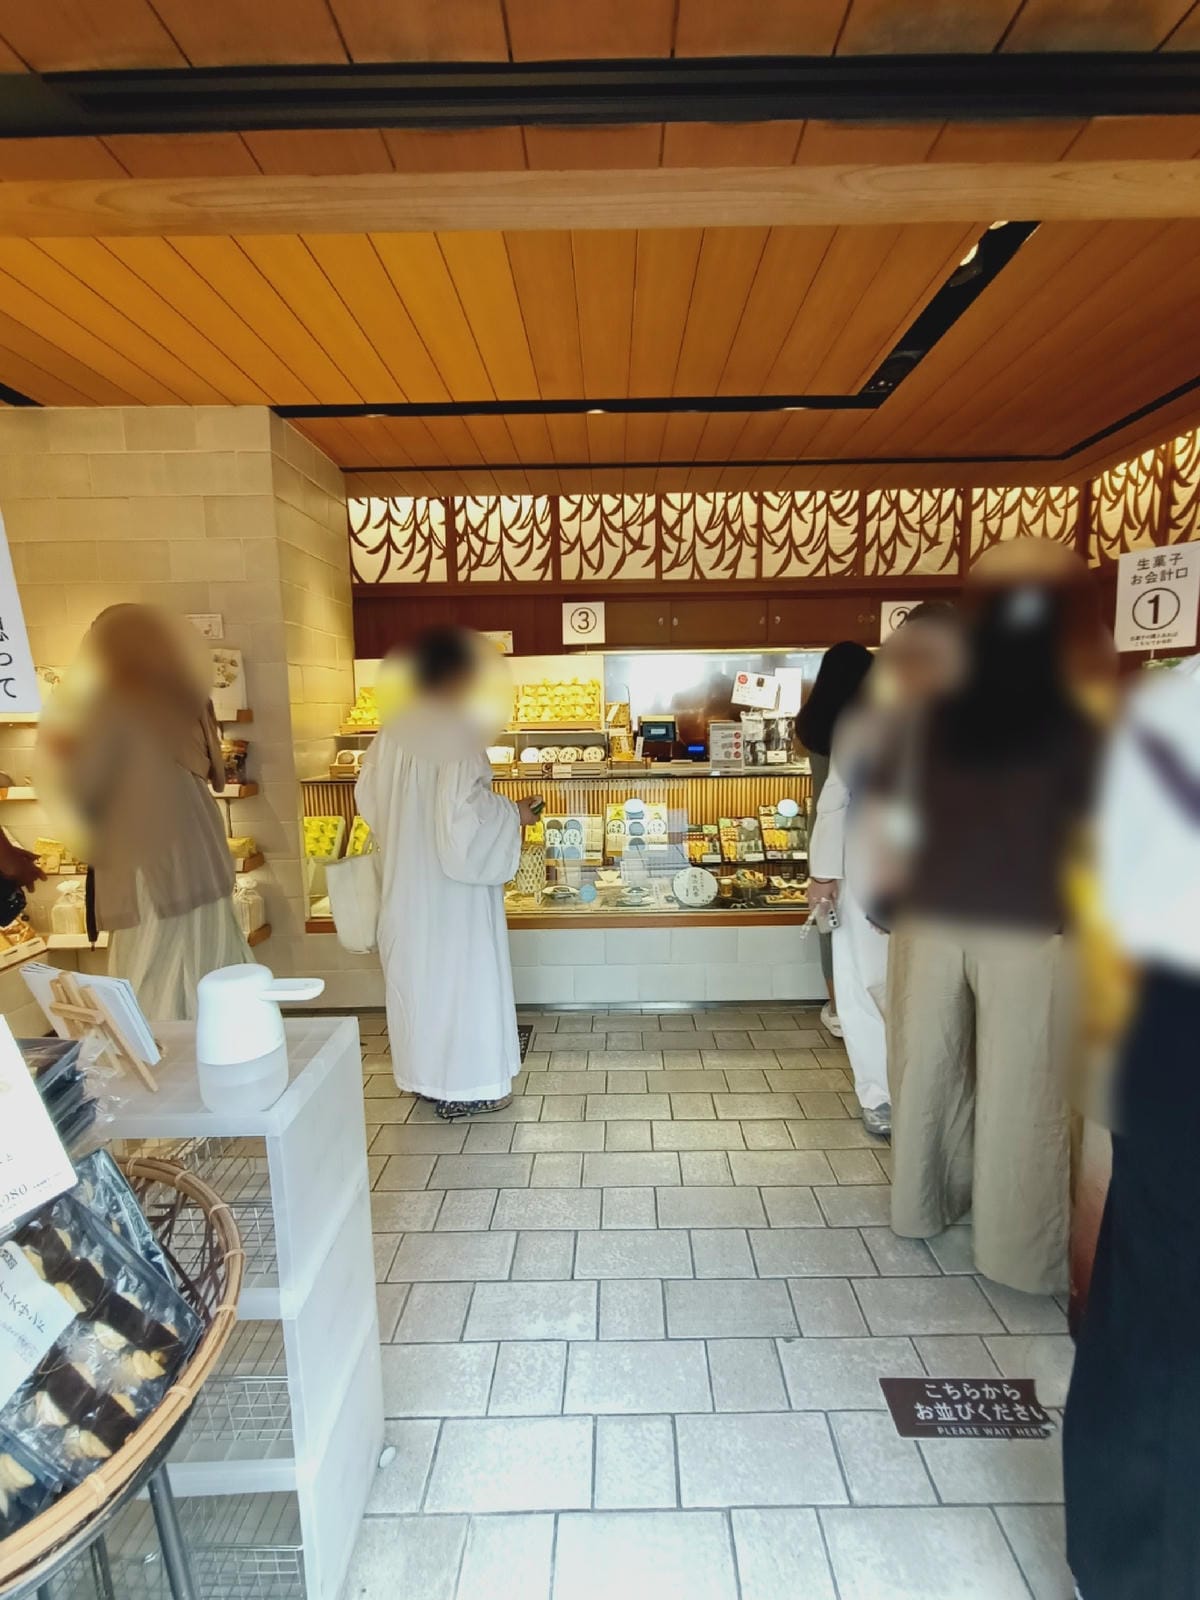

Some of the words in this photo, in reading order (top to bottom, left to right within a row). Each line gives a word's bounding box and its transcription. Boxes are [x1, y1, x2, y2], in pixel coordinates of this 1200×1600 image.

[1137, 553, 1183, 571] 生菓子
[1131, 567, 1188, 586] お会計口
[925, 1383, 1021, 1400] こちらから
[914, 1402, 1047, 1422] お並びください
[937, 1426, 979, 1436] PLEASE
[983, 1426, 1012, 1437] WAIT
[1016, 1427, 1045, 1437] HERE
